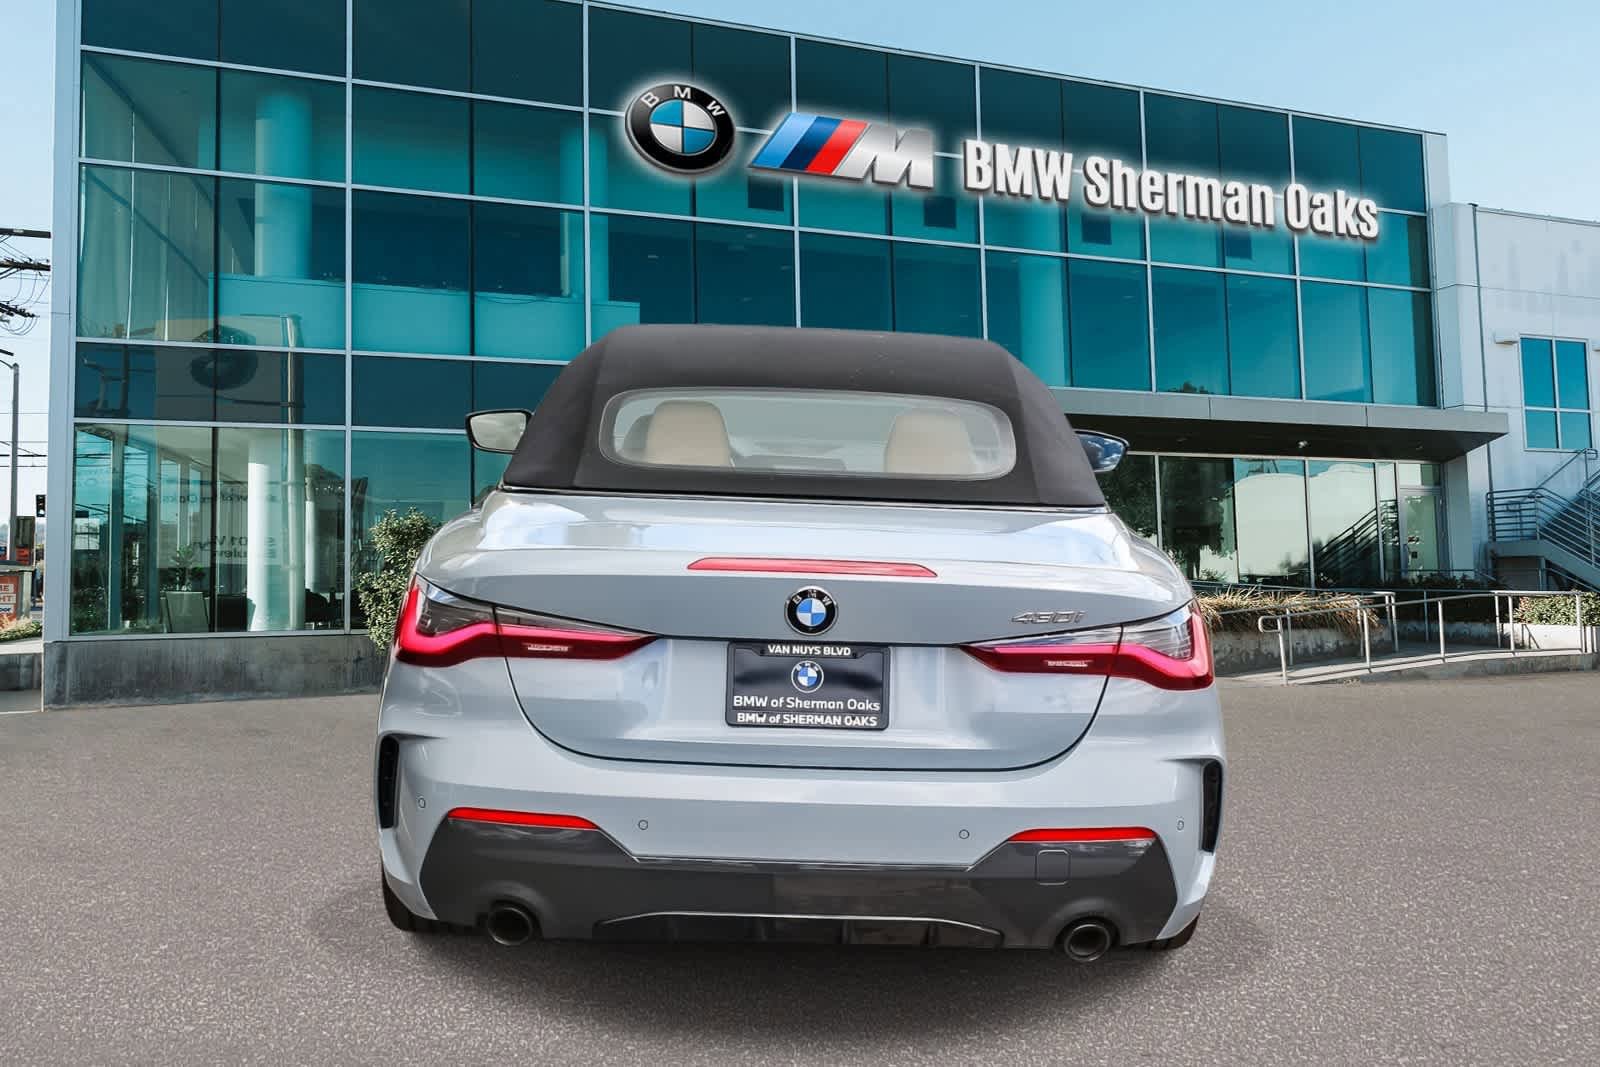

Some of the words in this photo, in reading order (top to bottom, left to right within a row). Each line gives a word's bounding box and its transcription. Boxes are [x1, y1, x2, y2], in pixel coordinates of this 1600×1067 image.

[641, 86, 726, 117] BMW
[963, 139, 1073, 201] BMW
[1083, 156, 1275, 227] Sherman
[1284, 183, 1379, 240] Oaks
[792, 589, 833, 606] BMW
[1011, 610, 1088, 624] 430i
[767, 644, 791, 654] VAN
[792, 645, 821, 655] NUYS
[823, 646, 851, 656] BLVD
[733, 695, 768, 707] BMW
[770, 697, 784, 708] of
[786, 697, 844, 710] Sherman
[847, 699, 881, 711] Oaks
[737, 713, 767, 723] BMW
[768, 713, 780, 723] of
[783, 714, 842, 725] SHERMAN
[844, 716, 878, 726] OAKS
